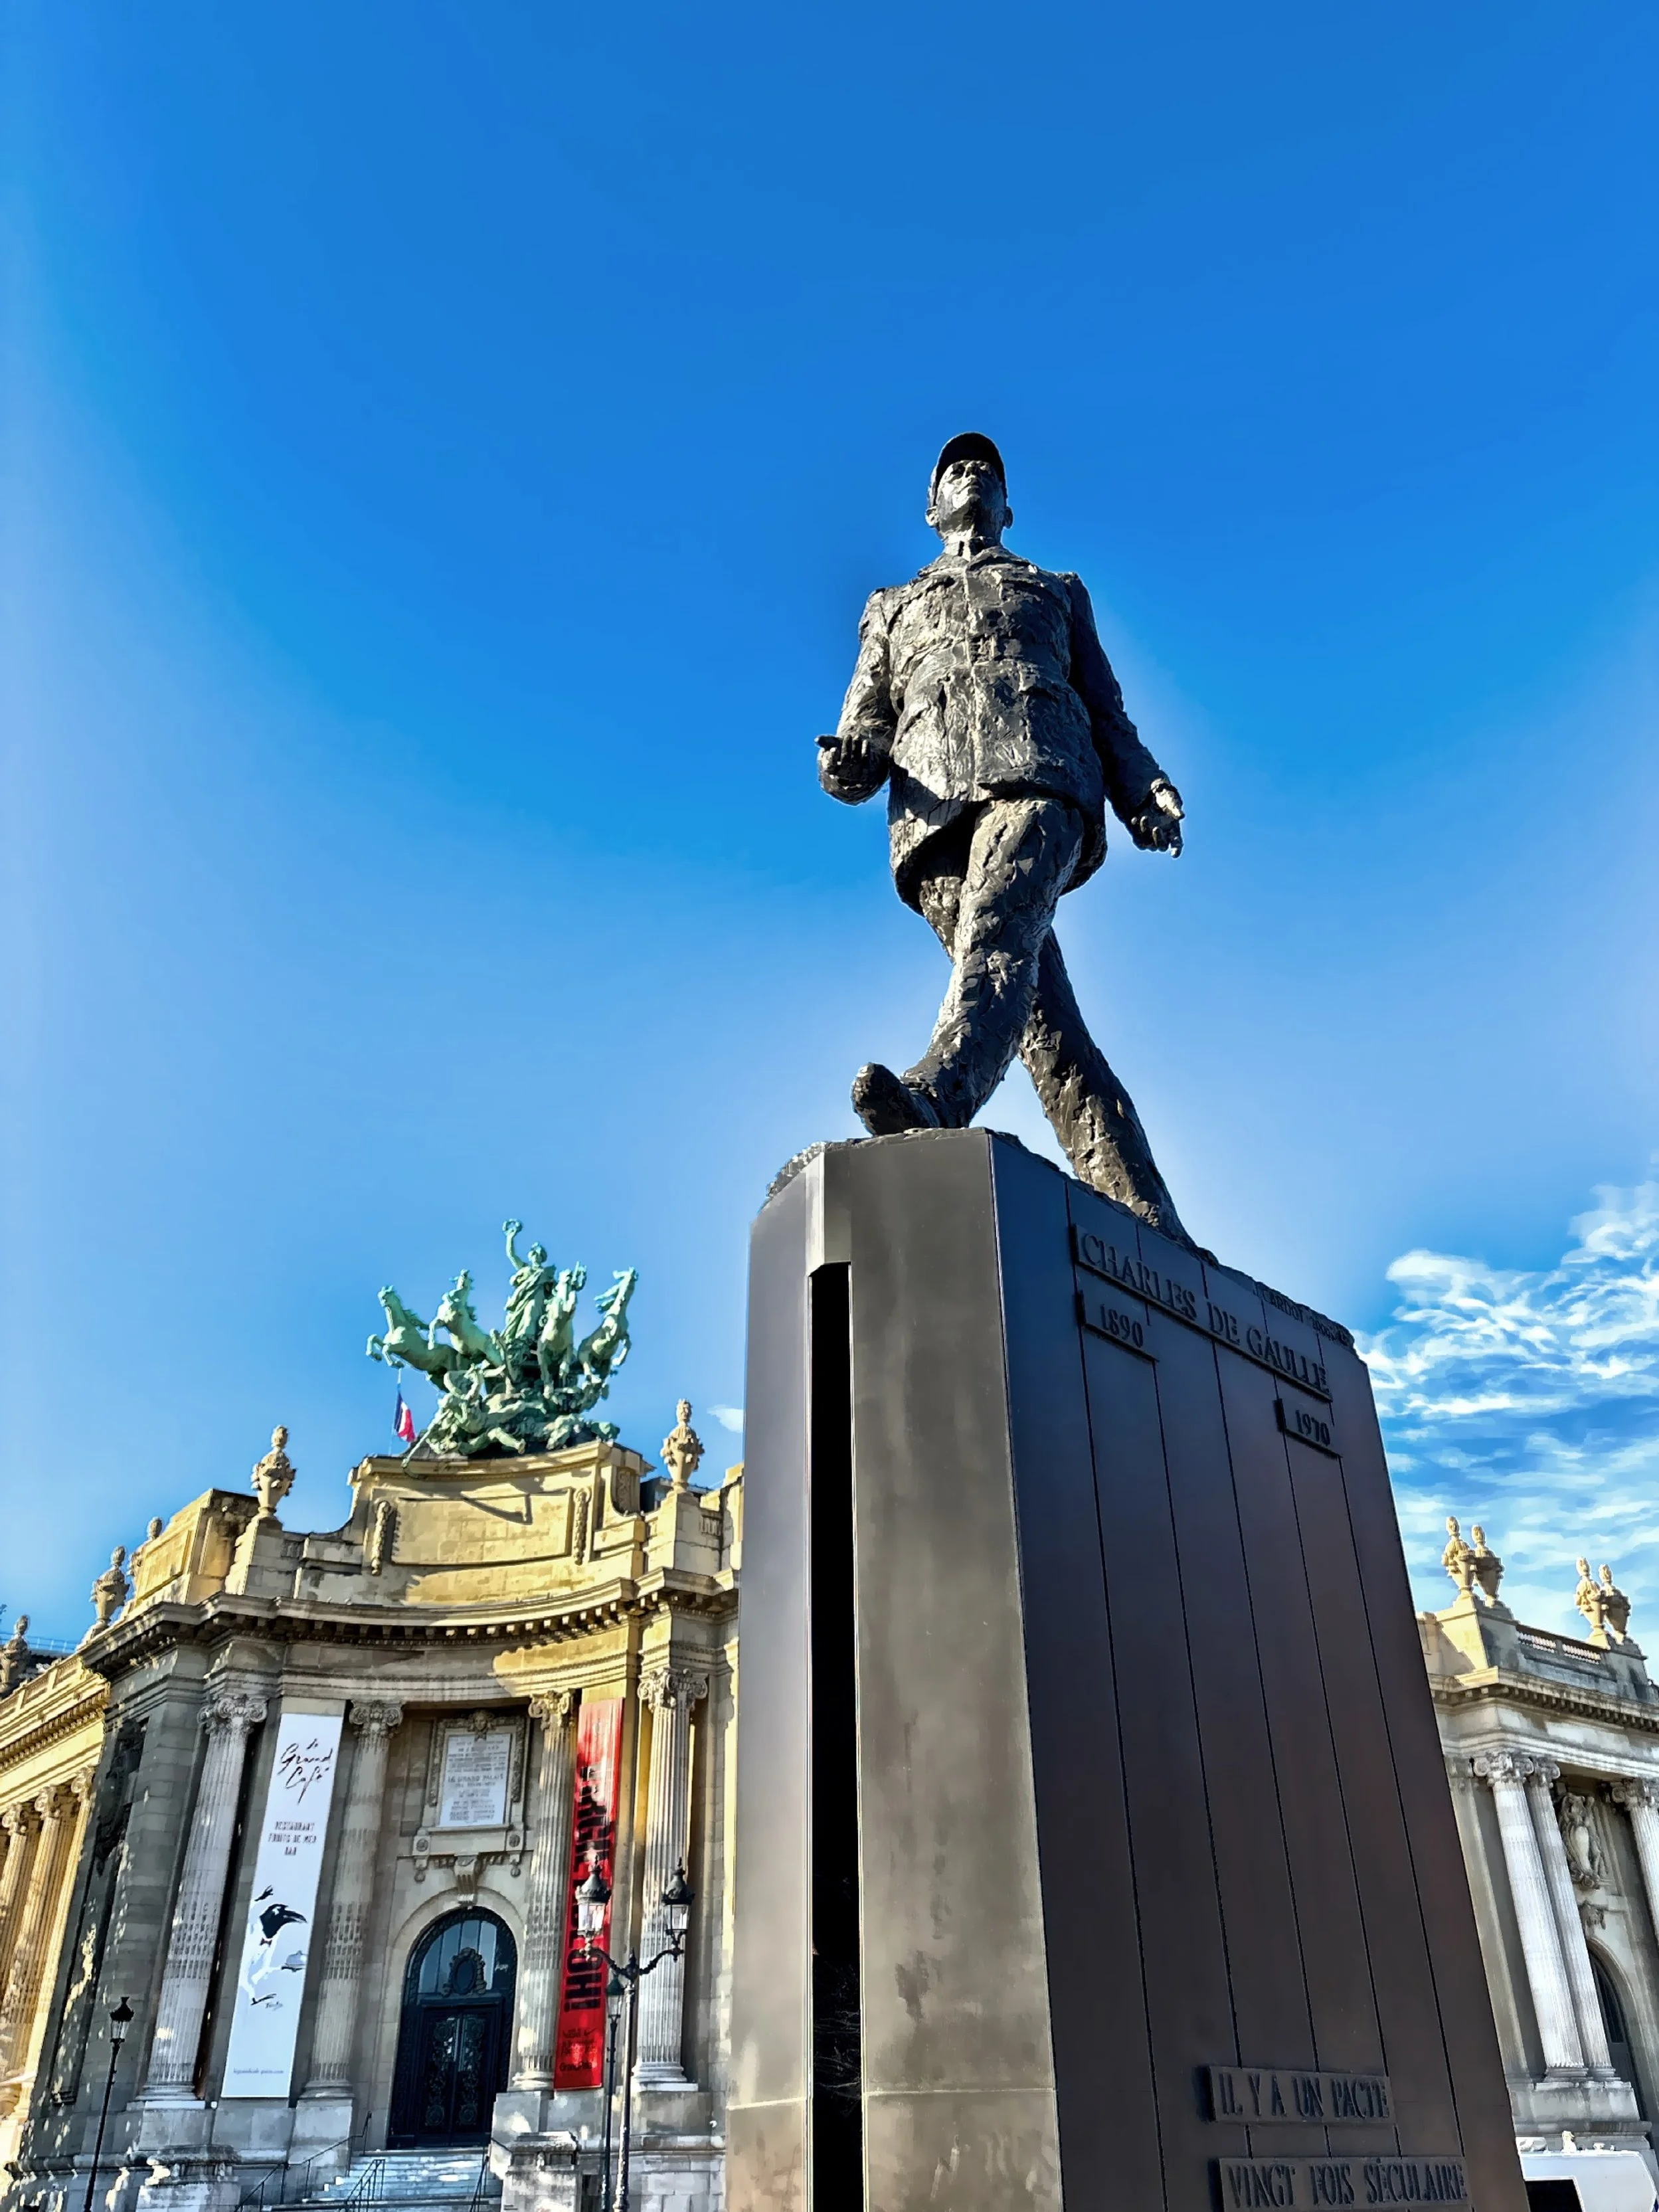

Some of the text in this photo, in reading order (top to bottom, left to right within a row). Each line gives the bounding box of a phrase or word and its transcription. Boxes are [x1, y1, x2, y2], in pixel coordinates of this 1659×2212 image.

[1081, 1234, 1330, 1396] CHARLES DE GAULLE
[1099, 1304, 1144, 1348] 1890
[1262, 1289, 1304, 1324] CARDOT
[1294, 1409, 1332, 1447] 1970
[277, 1742, 333, 1776] Grand
[286, 1766, 331, 1805] Café
[1219, 2073, 1390, 2118] IL Y A UN PACTE
[1228, 2158, 1468, 2209] VINGT FOIS SÉCULAIRE
